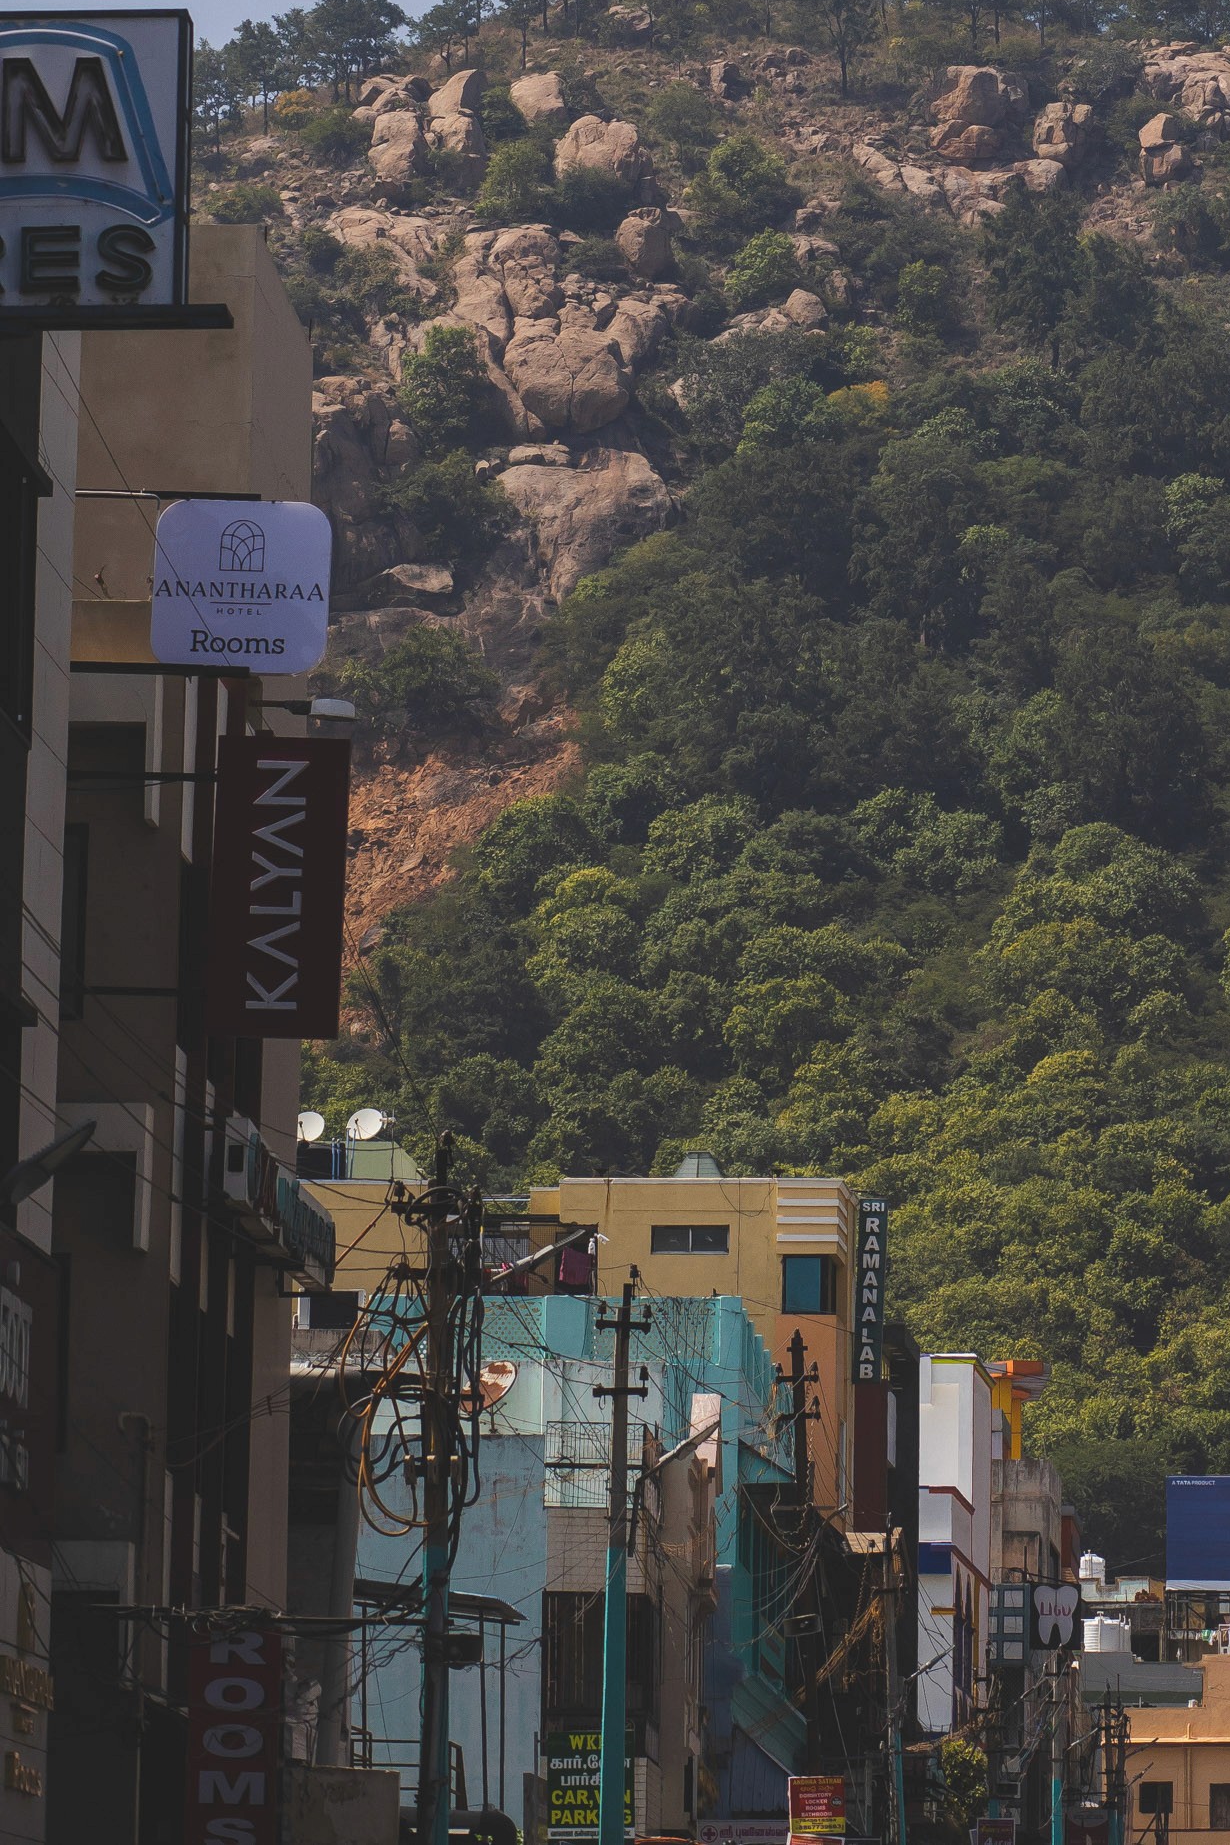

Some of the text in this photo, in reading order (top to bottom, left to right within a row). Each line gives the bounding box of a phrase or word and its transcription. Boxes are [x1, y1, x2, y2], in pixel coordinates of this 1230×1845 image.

[0, 224, 156, 293] ES
[154, 579, 325, 602] ANANTHARAA
[216, 607, 263, 616] HOTEL
[189, 628, 285, 655] Rooms
[245, 759, 311, 1011] KALYAN
[862, 1202, 885, 1212] SRI
[859, 1217, 881, 1380] RAMANA LAB
[198, 1629, 267, 1845] ROOMS
[551, 1789, 632, 1808] CAR,N
[551, 1809, 632, 1825] PARKG
